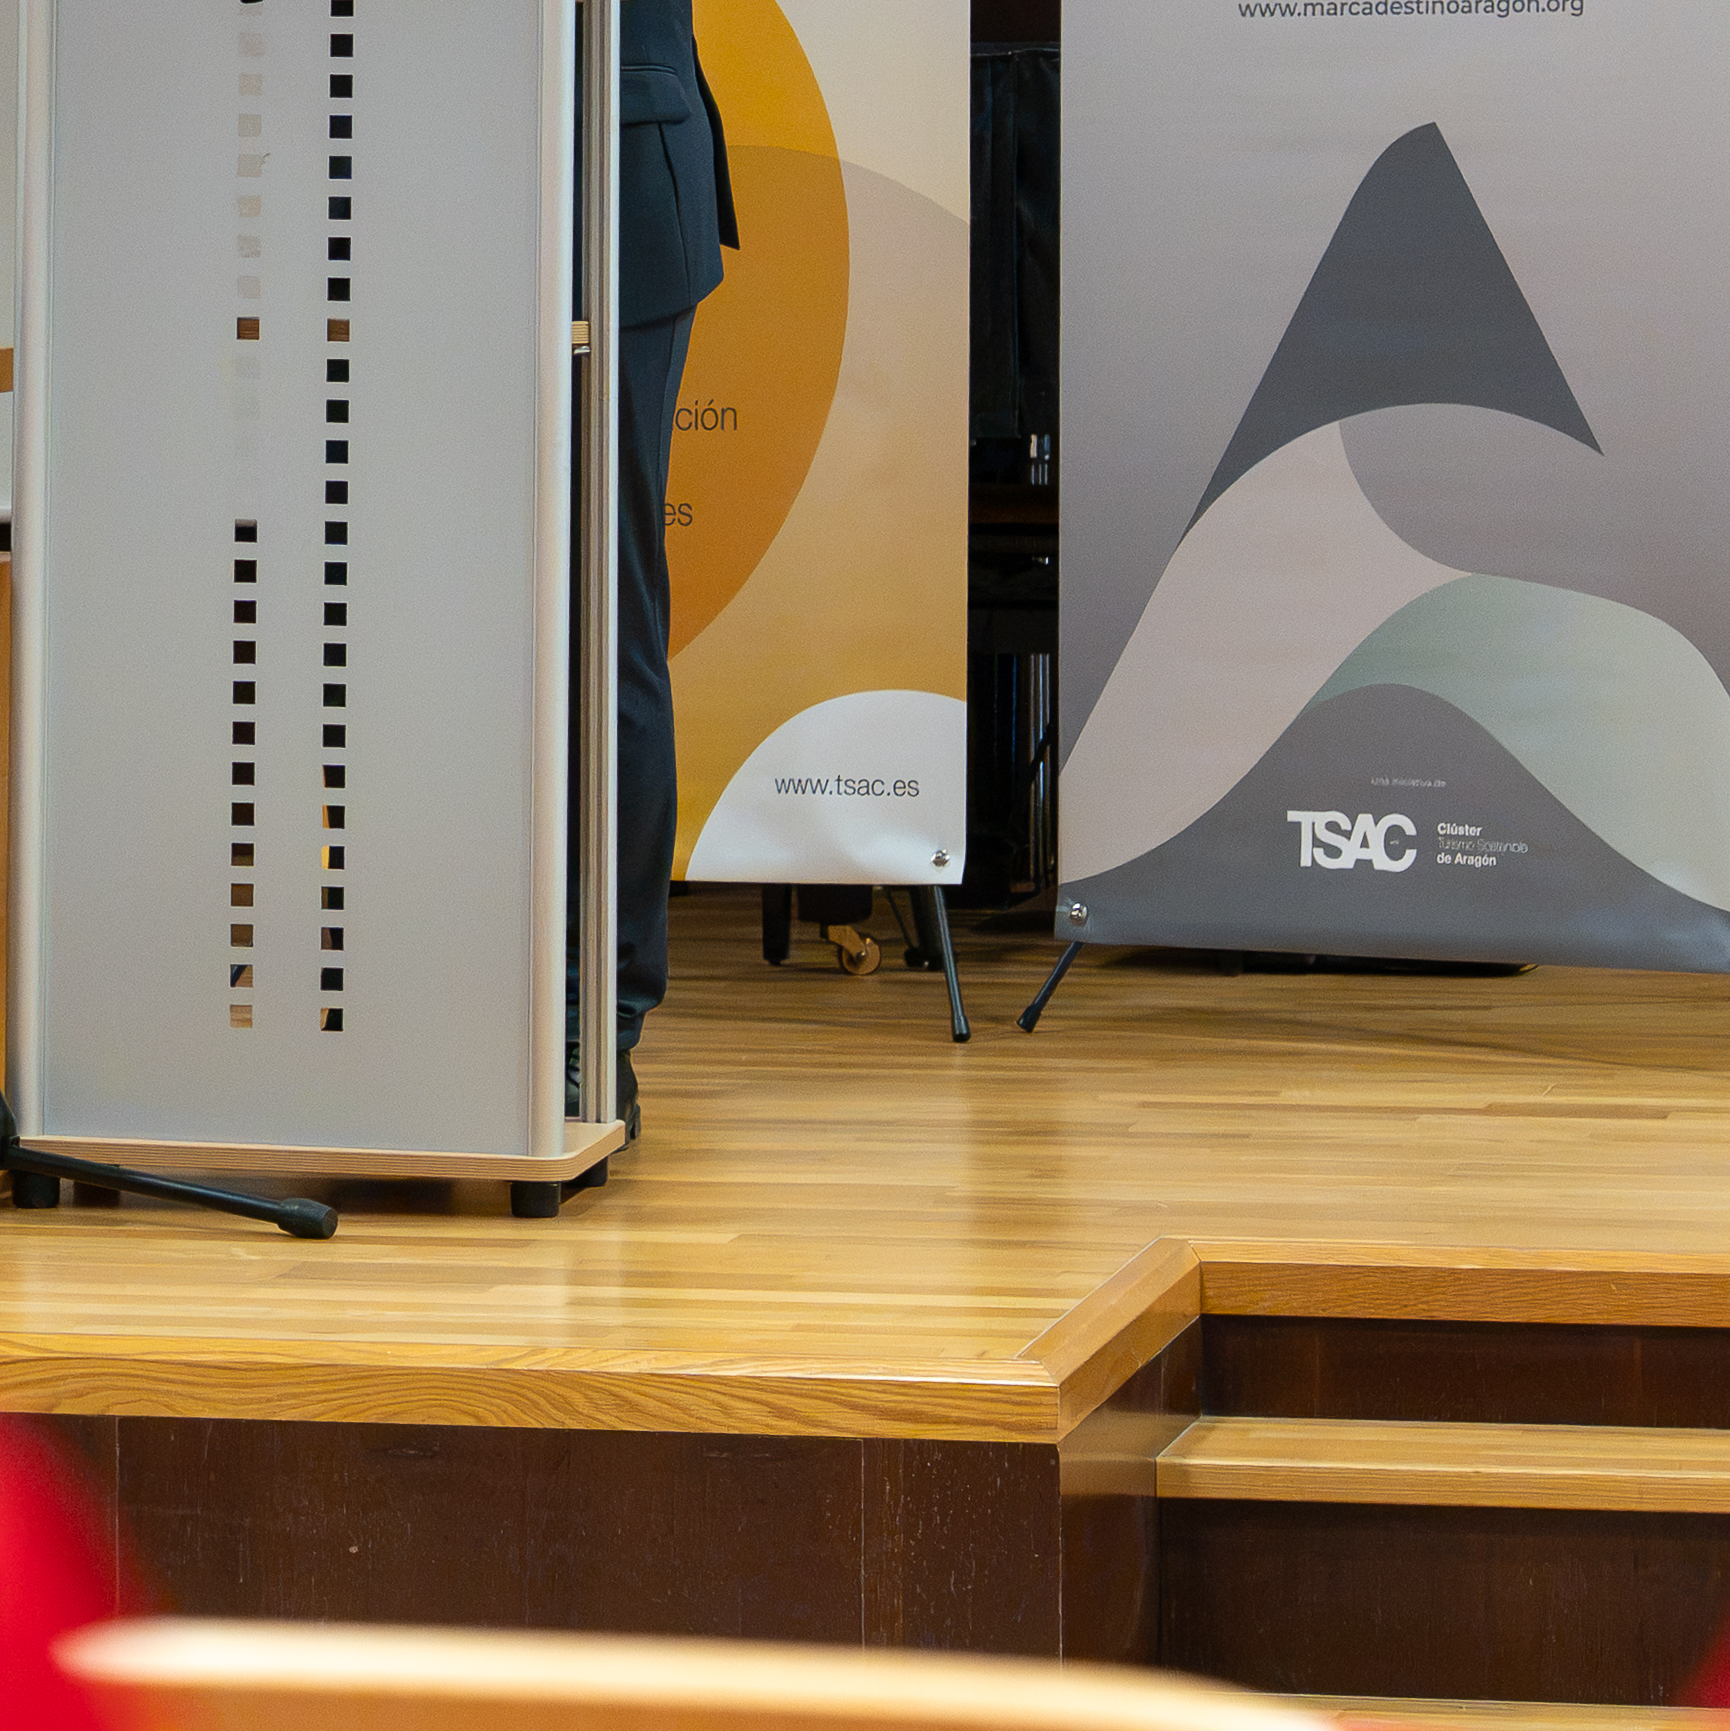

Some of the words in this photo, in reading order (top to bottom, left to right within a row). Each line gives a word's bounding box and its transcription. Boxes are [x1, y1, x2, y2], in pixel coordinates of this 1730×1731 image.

[774, 773, 920, 798] www.tsac.es
[1437, 822, 1483, 837] Clúster
[1286, 810, 1418, 873] TSAC
[1437, 852, 1452, 865] de
[1454, 852, 1497, 868] Aragón
